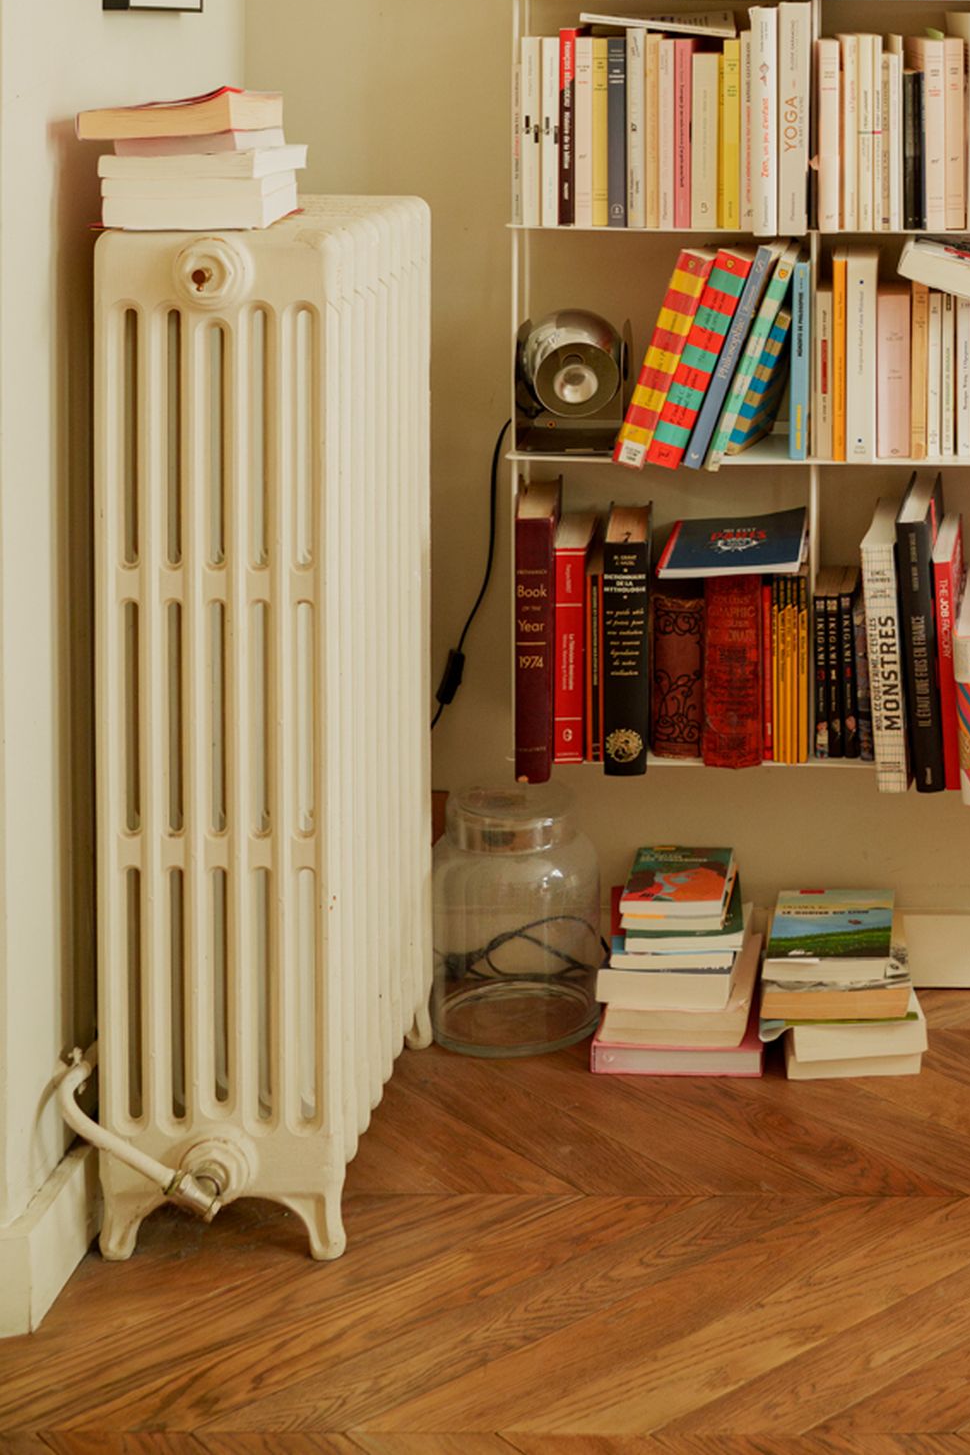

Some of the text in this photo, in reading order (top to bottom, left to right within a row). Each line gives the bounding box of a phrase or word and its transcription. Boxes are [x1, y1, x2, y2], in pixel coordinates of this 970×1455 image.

[784, 96, 798, 152] YOGA
[760, 97, 771, 178] Zen, un jeu d'enfant
[718, 317, 747, 380] Philosophie
[517, 584, 547, 598] Book
[604, 585, 646, 593] MYTHOLOGIE
[518, 619, 545, 633] Year
[910, 615, 926, 642] FRANCE
[939, 579, 951, 658] THE JOB FACTORY
[843, 615, 851, 663] IKIGAMI
[519, 654, 544, 669] 1974
[912, 645, 927, 657] EN
[878, 615, 901, 731] MONSTRES
[913, 658, 928, 677] FOIS
[914, 678, 929, 695] UNE
[914, 696, 931, 719] ÉTAIT
